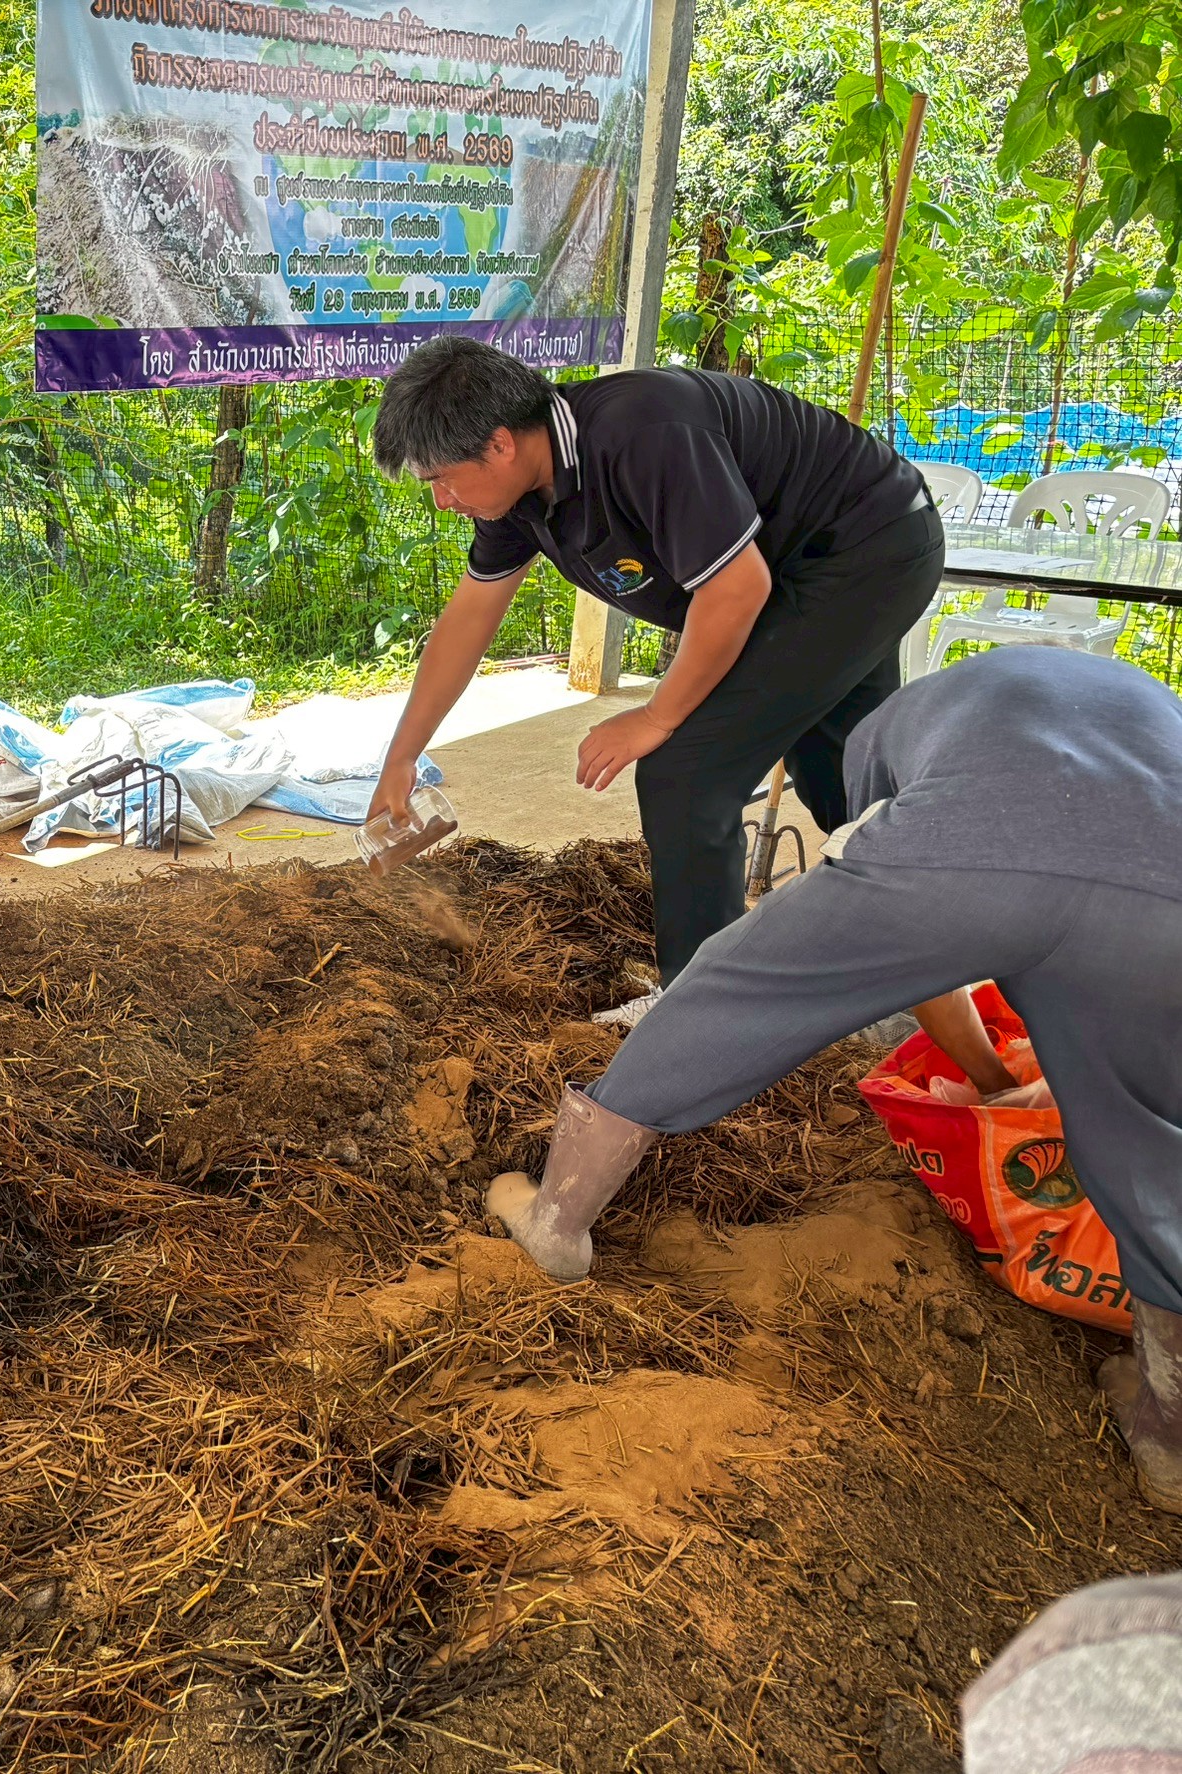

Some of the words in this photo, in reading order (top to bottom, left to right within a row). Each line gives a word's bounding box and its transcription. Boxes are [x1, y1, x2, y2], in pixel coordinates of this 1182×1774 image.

[132, 43, 599, 130] กิจกรรมลดการเผาวัสดุเหลือใช้ทางการเกษตรในเขตปฏิรูปที่ดิน
[253, 111, 407, 160] ประจำปีงบประมาณ
[415, 131, 453, 164] พ.ศ.
[463, 133, 514, 167] 2569
[254, 176, 269, 196] ณ
[375, 248, 470, 275] อำเภอเมืองบึงกาฬ
[476, 250, 540, 275] จังหวัดบึงกาฬ
[289, 281, 316, 312] วันที่
[323, 289, 345, 312] 28
[352, 291, 409, 316] พฤษภาคม
[415, 288, 441, 310] พ.ศ.
[448, 287, 482, 309] 2569
[139, 335, 174, 376] โดย
